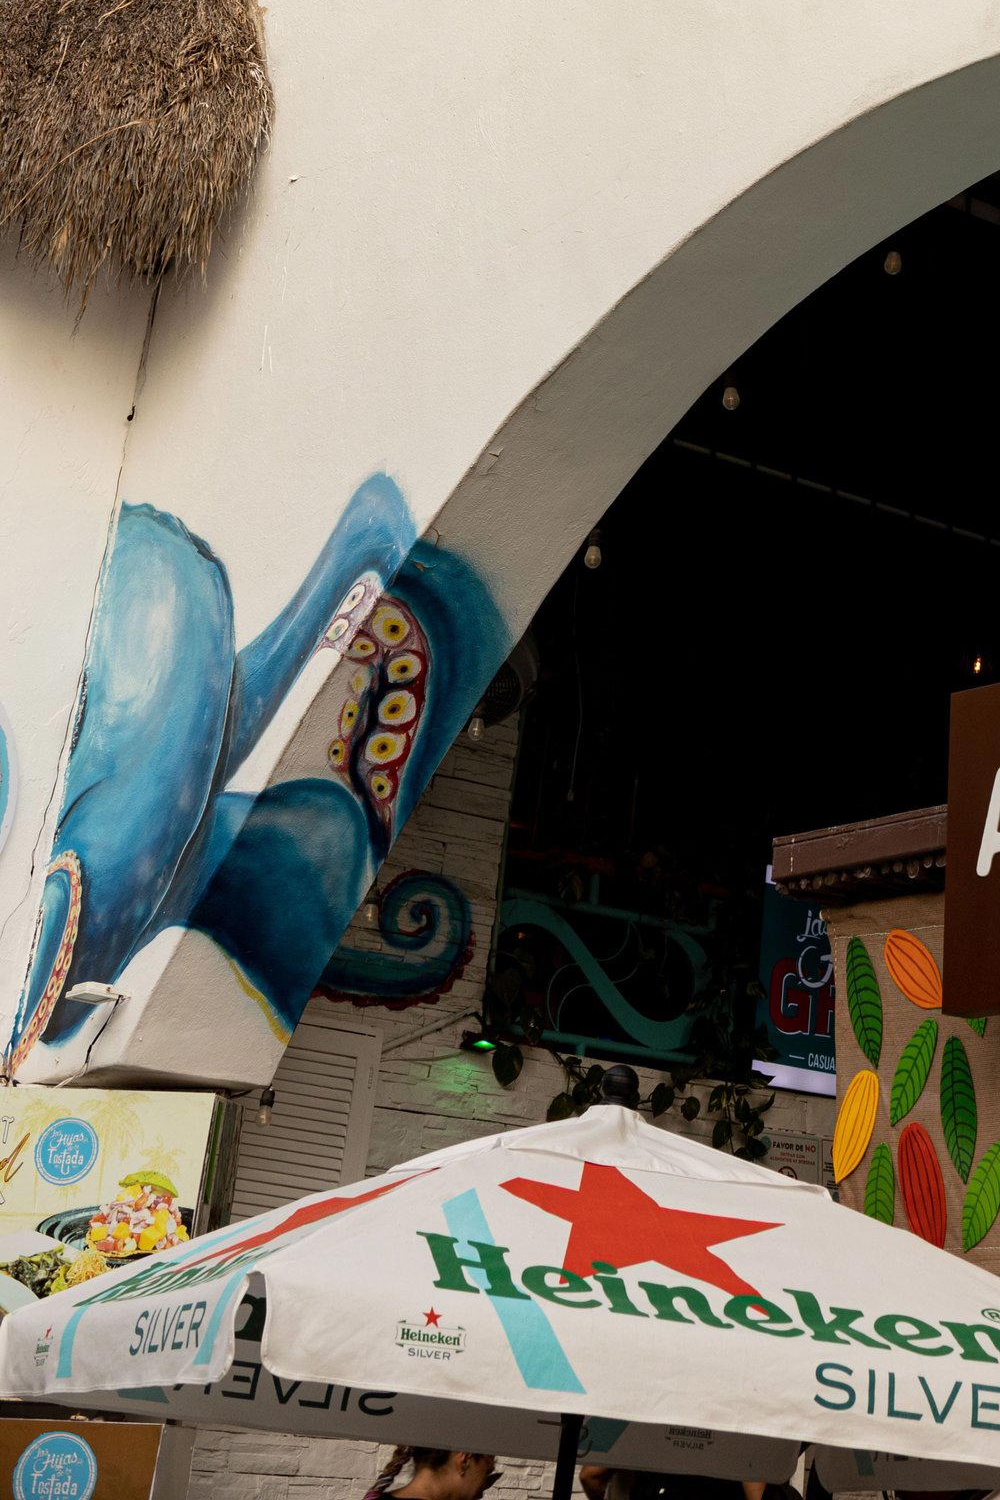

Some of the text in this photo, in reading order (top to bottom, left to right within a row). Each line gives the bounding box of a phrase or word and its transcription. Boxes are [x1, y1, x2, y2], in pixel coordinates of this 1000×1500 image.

[808, 1053, 835, 1071] CASUA
[773, 1141, 794, 1150] FAVOR
[805, 1144, 816, 1153] NO
[130, 1301, 207, 1356] SILVER
[401, 1328, 460, 1346] Heineken
[408, 1348, 451, 1361] SILVER
